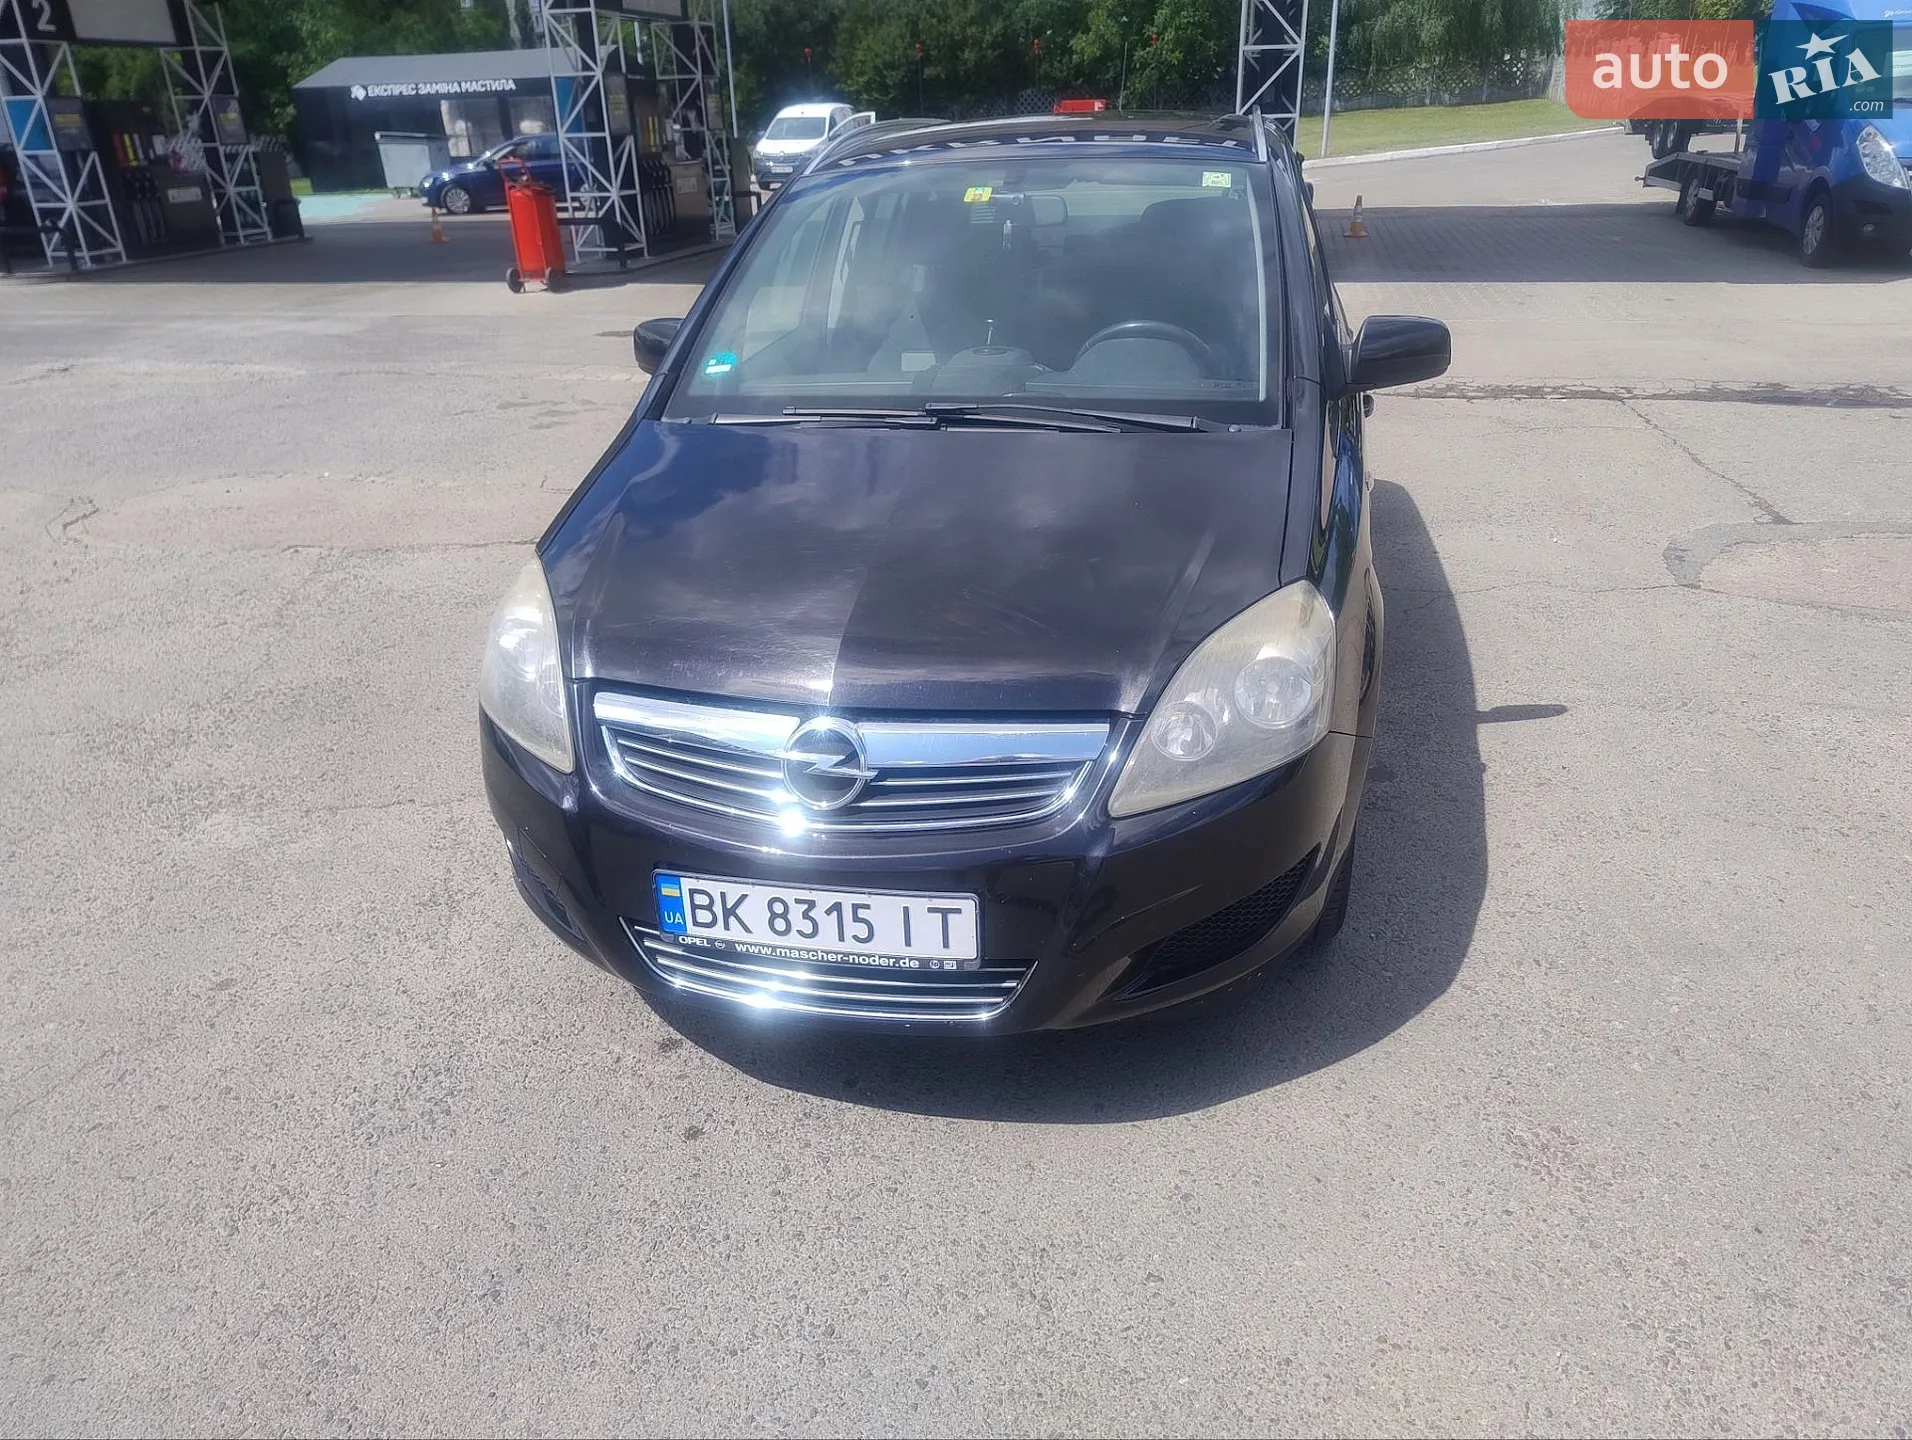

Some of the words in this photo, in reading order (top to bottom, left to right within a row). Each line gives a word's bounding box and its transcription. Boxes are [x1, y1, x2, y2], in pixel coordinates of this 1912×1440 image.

[32, 0, 57, 32] 2
[367, 83, 417, 96] ЕКСПРЕС
[418, 81, 461, 95] ЗАМІНА
[462, 79, 516, 93] МАСТИЛА
[664, 911, 684, 924] UA
[688, 887, 754, 934] BK
[767, 896, 875, 944] 8315
[902, 906, 962, 949] IT
[678, 935, 711, 947] OPEL
[735, 942, 920, 968] www.mascher-noder.de
